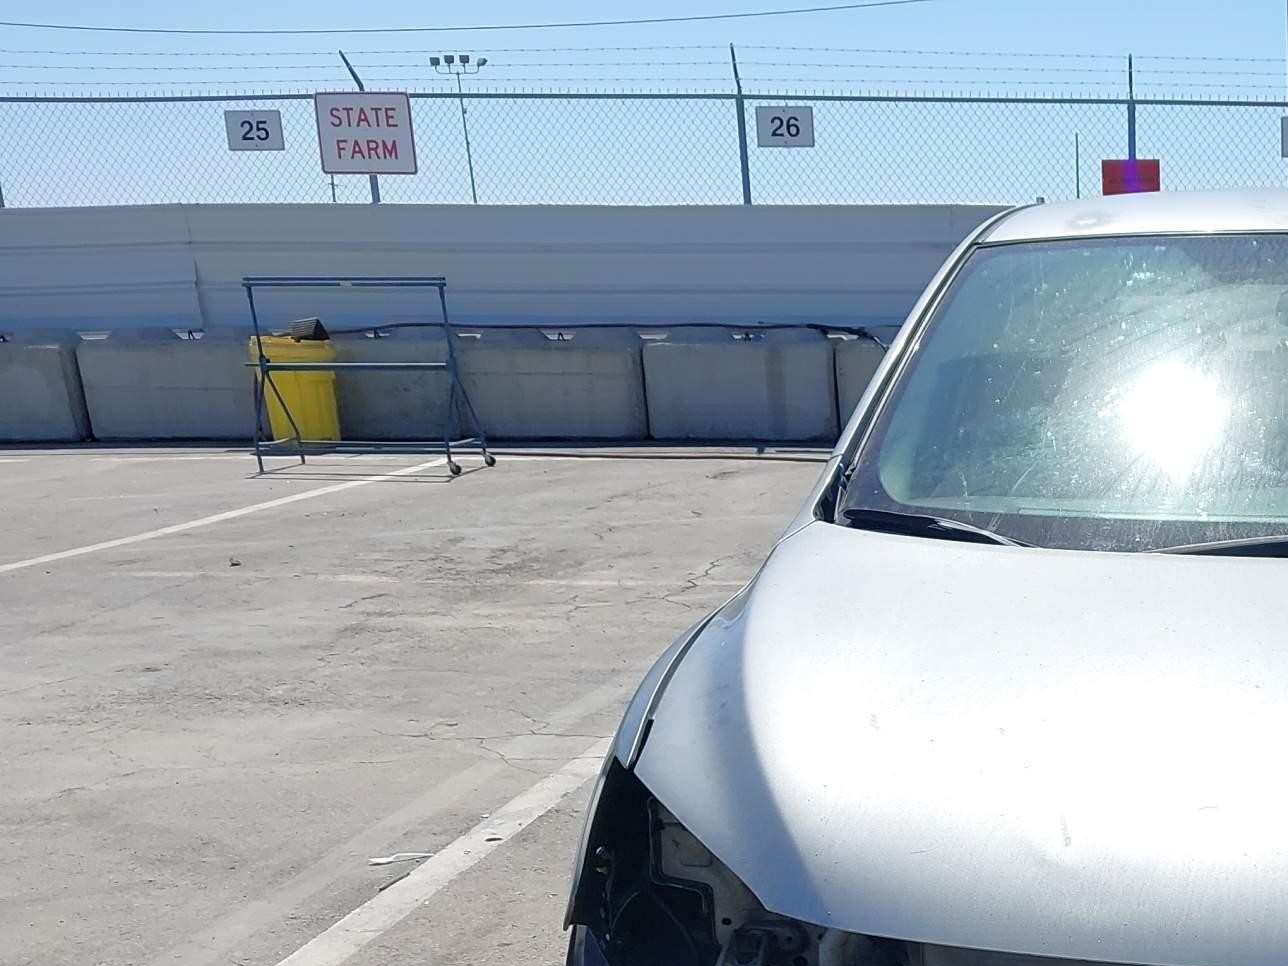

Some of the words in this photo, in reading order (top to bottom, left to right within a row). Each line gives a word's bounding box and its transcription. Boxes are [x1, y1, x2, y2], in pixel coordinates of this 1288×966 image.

[329, 107, 398, 129] STATE
[769, 117, 800, 138] 26
[239, 120, 270, 142] 25
[336, 139, 399, 161] FARM
